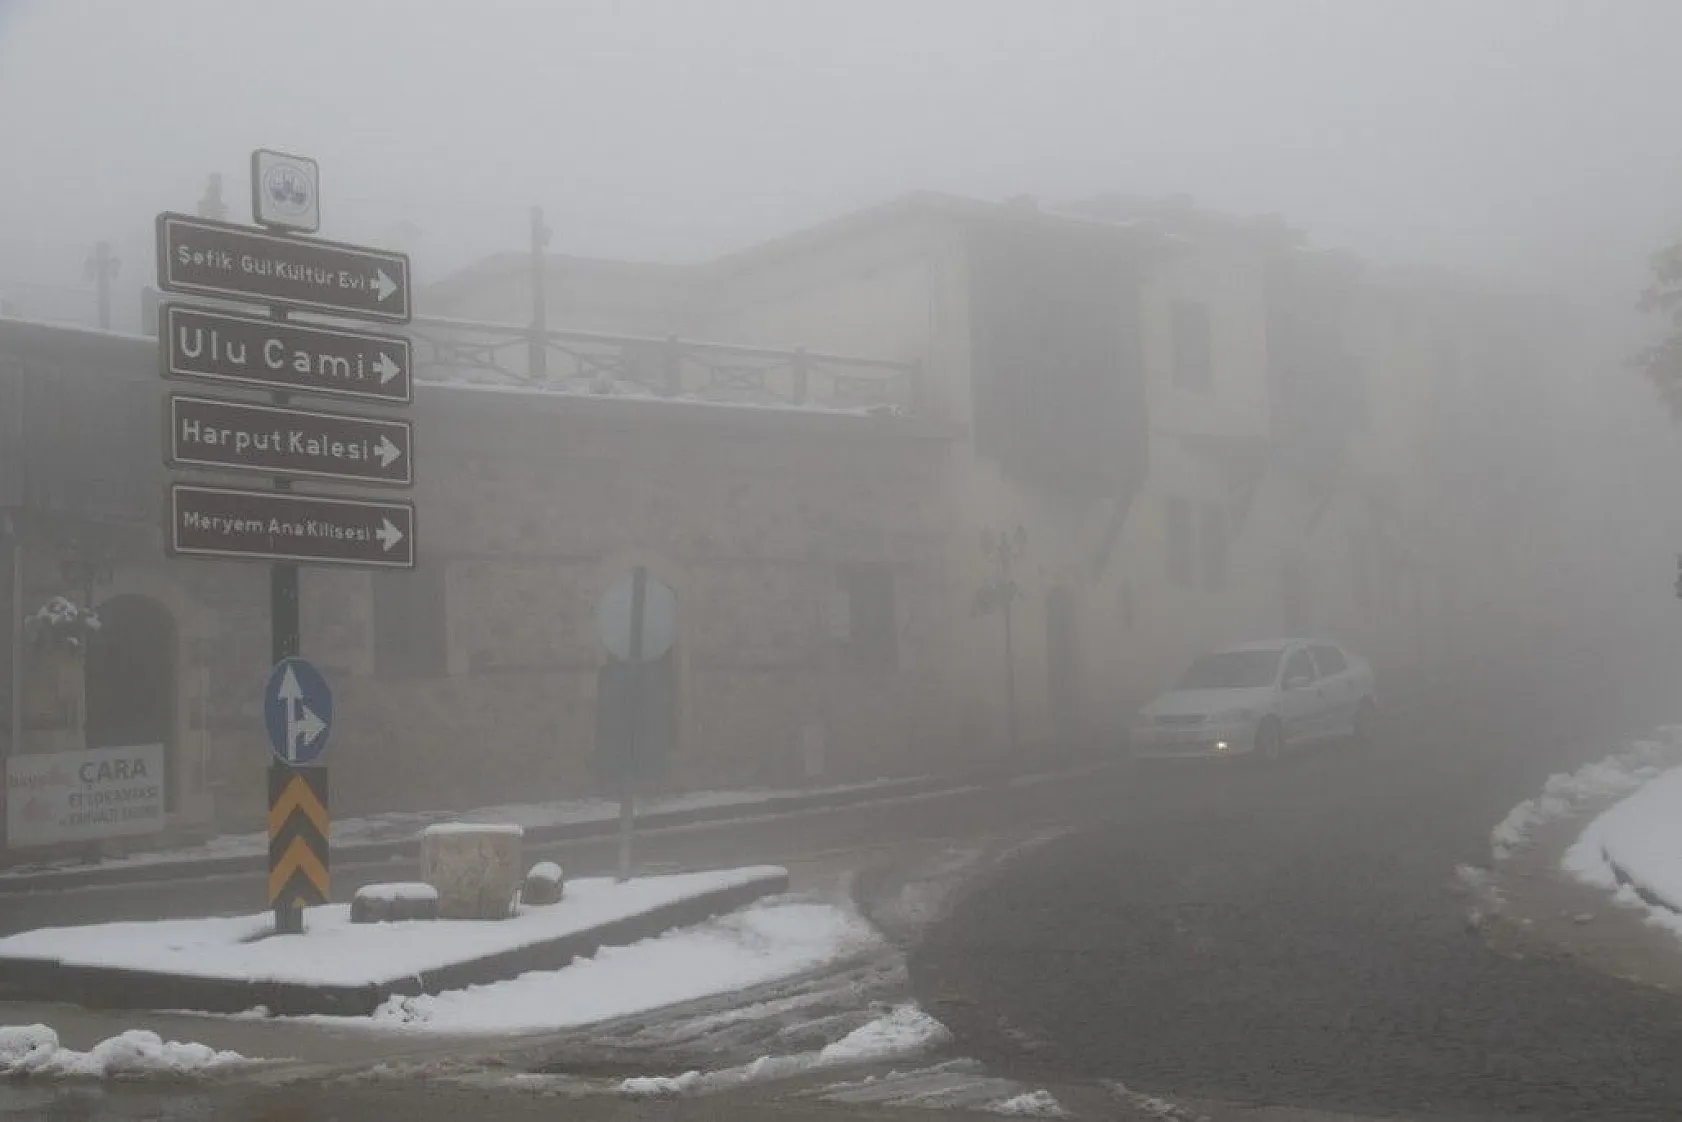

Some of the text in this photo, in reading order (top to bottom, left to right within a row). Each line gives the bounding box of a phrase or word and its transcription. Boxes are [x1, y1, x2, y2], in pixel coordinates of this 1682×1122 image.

[339, 271, 365, 290] Evi
[180, 326, 364, 379] Ulu Cami
[182, 418, 369, 461] Harput Kalesi
[183, 511, 371, 542] Meryem Ana Kilisesi
